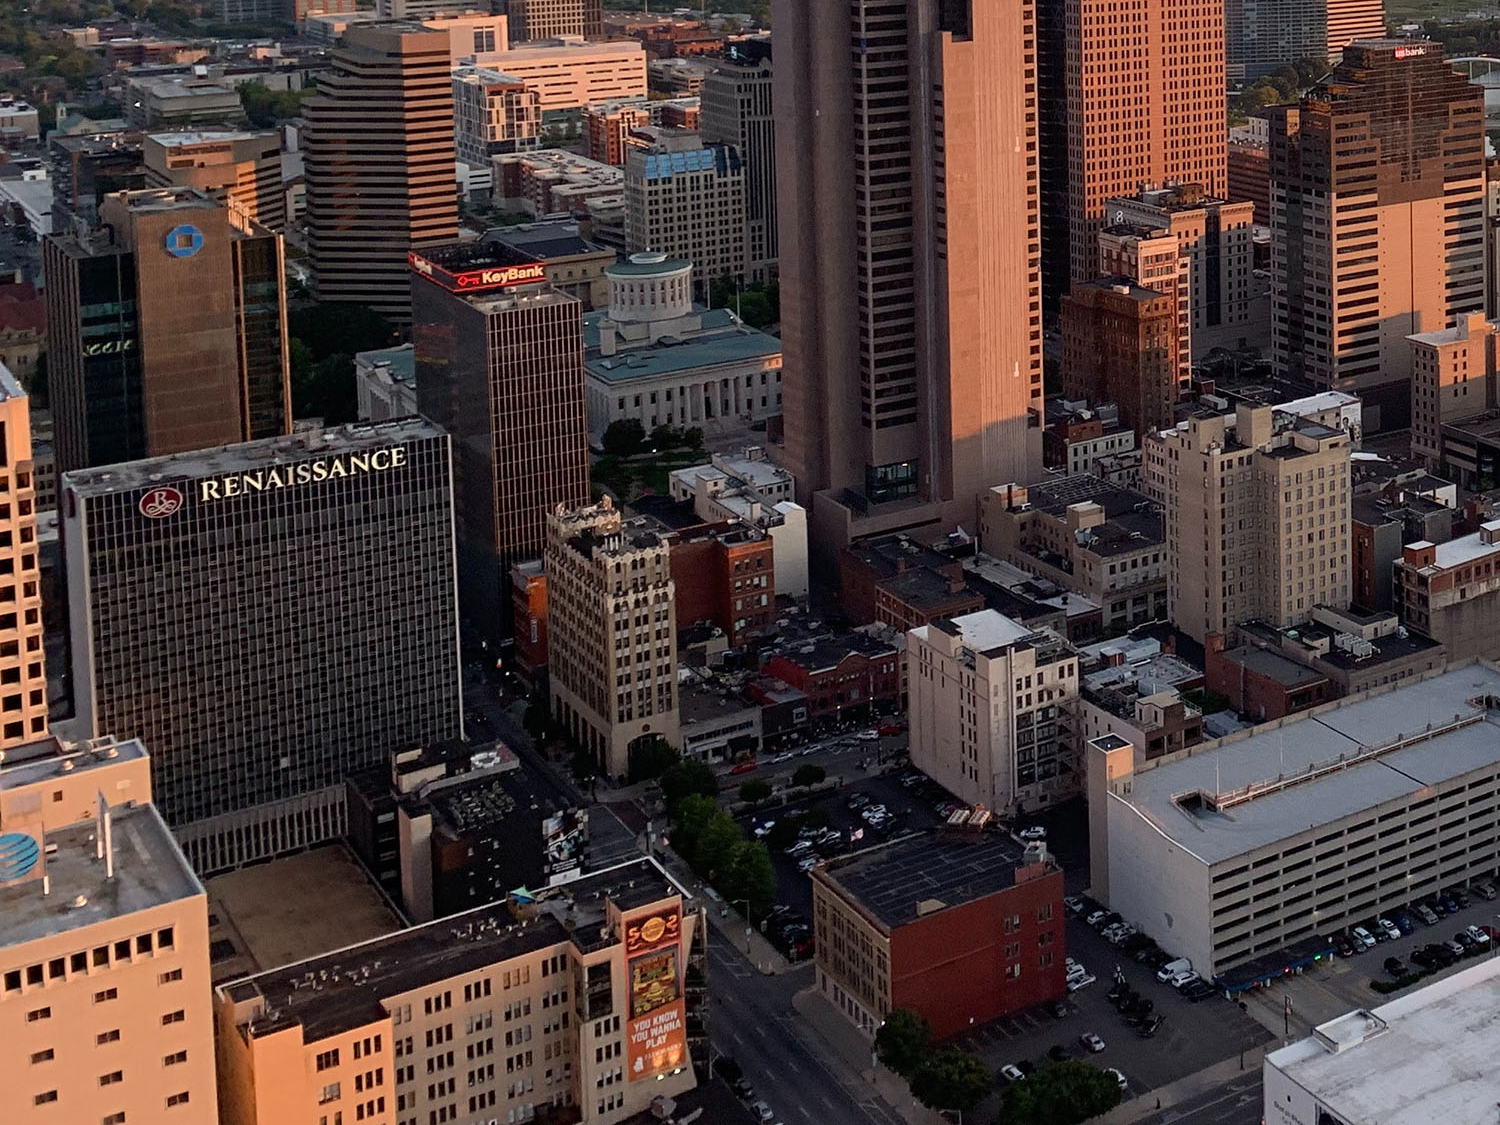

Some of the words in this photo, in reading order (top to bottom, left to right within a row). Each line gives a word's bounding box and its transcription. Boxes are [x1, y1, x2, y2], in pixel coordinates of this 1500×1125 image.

[1116, 210, 1124, 223] 8
[482, 266, 544, 284] KeyBank
[200, 446, 407, 502] RENAISSANCE
[631, 1029, 648, 1044] YOU
[650, 1018, 682, 1038] WANNA
[633, 1018, 651, 1033] YOU
[652, 1008, 678, 1026] KNOW
[645, 1033, 668, 1050] PLAY
